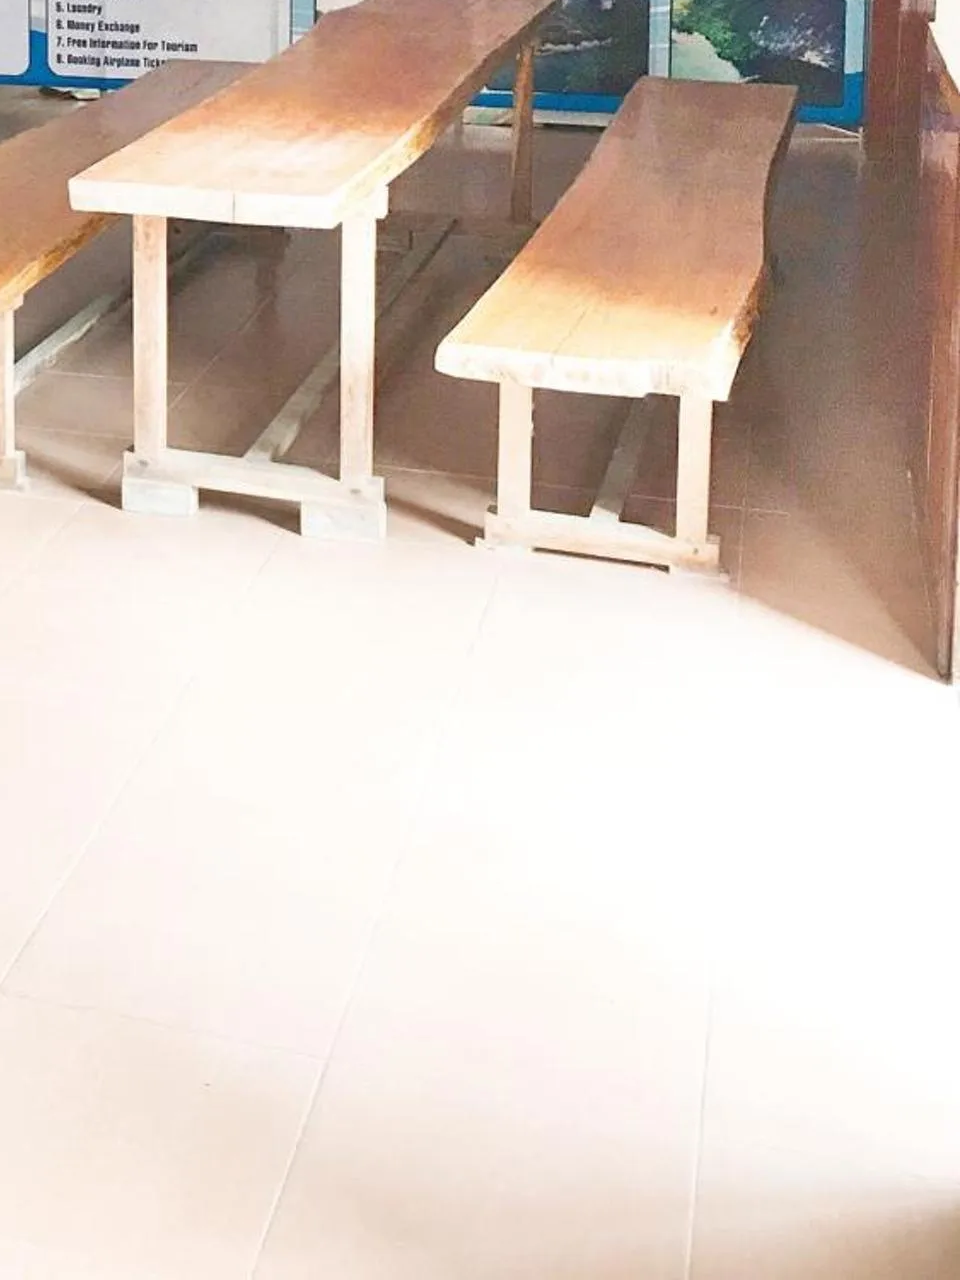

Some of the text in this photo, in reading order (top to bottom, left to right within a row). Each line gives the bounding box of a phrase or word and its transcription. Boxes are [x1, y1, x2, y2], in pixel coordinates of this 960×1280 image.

[67, 3, 102, 15] Laundry
[67, 20, 95, 32] Money
[98, 21, 140, 33] Exchange
[56, 37, 198, 52] 7. Free Information For Tourism
[67, 55, 100, 67] Booking
[103, 56, 140, 67] Airplane
